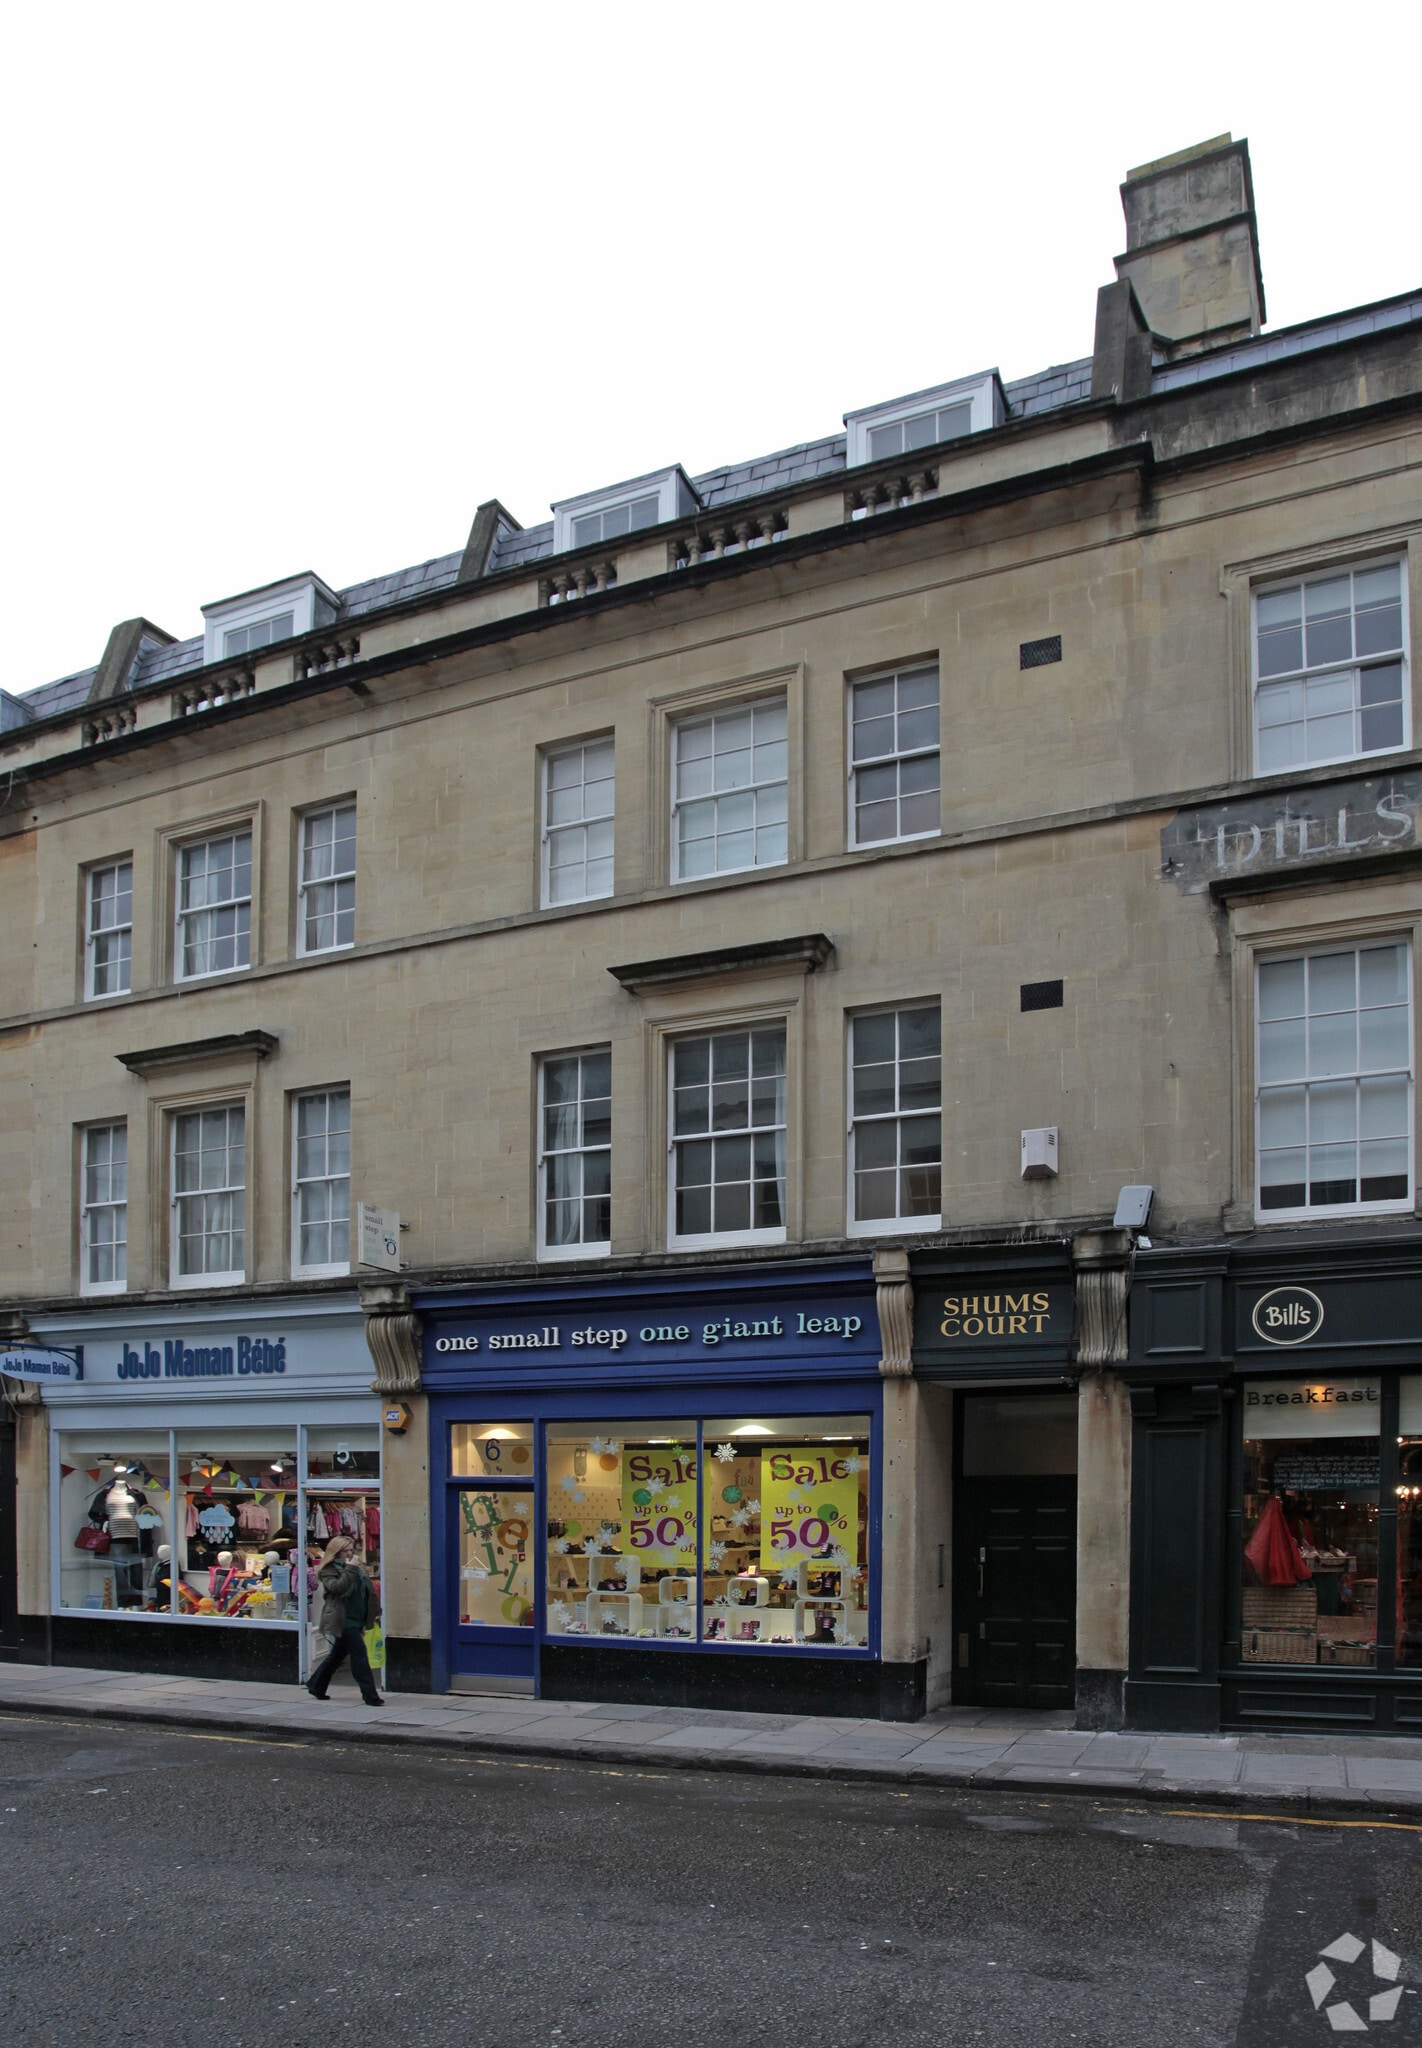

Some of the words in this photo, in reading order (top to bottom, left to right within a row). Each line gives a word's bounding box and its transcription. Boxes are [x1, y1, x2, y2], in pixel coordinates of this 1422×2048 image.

[364, 1215, 383, 1225] small
[364, 1225, 379, 1235] step
[943, 1292, 1050, 1316] SHUMS
[1265, 1302, 1312, 1327] Bill's
[435, 1335, 479, 1352] one
[488, 1326, 561, 1349] small
[571, 1326, 628, 1350] step
[639, 1324, 690, 1342] one
[702, 1315, 783, 1344] giant
[796, 1312, 862, 1338] leap
[940, 1314, 1051, 1337] COURT
[3, 1357, 22, 1372] JoJo
[23, 1358, 52, 1374] Maman
[52, 1360, 71, 1376] Bébé
[117, 1341, 161, 1380] JoJo
[164, 1339, 234, 1377] Maman
[237, 1335, 286, 1375] Bébé
[1246, 1387, 1378, 1406] Breakfast
[385, 1412, 400, 1420] ADT
[336, 1442, 350, 1465] 5
[485, 1438, 500, 1462] 6
[769, 1453, 851, 1487] Sale
[634, 1505, 652, 1517] up
[654, 1504, 669, 1514] to
[775, 1506, 794, 1518] up
[796, 1504, 812, 1515] to
